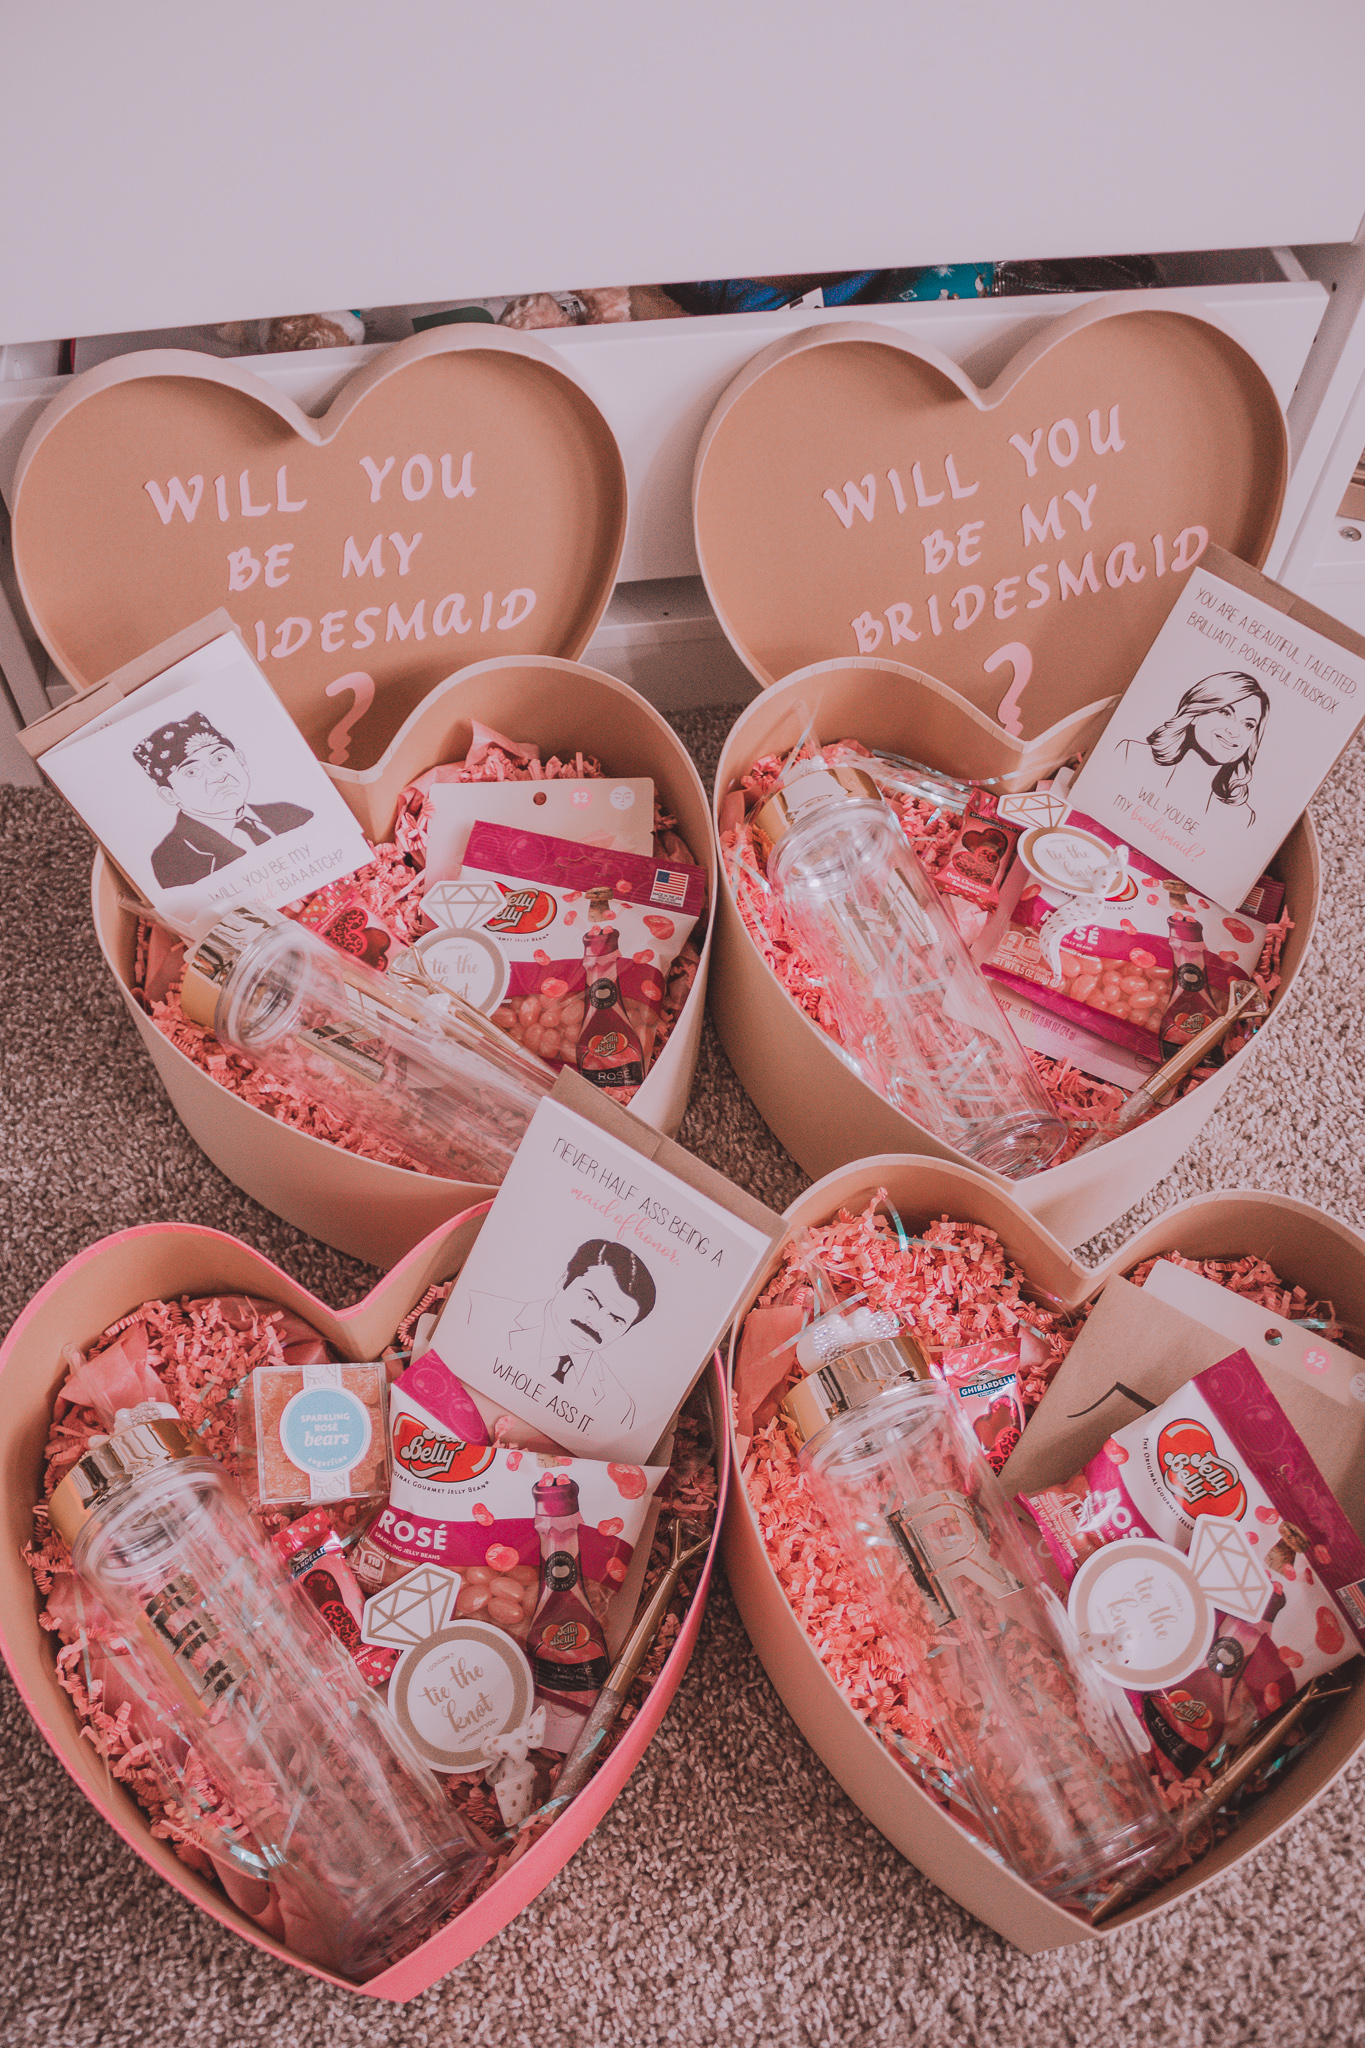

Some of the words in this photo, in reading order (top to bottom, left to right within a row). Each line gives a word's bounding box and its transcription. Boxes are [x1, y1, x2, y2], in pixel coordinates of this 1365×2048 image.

[143, 464, 307, 525] WILL
[359, 451, 476, 503] YOU
[822, 453, 979, 529] WILL
[1008, 404, 1126, 478] YOU
[921, 520, 985, 574] BE
[1021, 483, 1097, 547] MY
[226, 542, 294, 591] BE
[341, 531, 423, 578] MY
[850, 525, 1209, 654] BRIDESMAID
[252, 588, 537, 662] IDESMAID
[1195, 586, 1218, 609] YOU
[1216, 602, 1240, 622] ARE
[1237, 616, 1249, 630] A
[1303, 653, 1357, 699] TALENTED,
[1237, 643, 1292, 687] POWERFUL
[983, 641, 1034, 737] ?
[325, 671, 376, 765] ?
[572, 791, 588, 804] $2
[1138, 786, 1160, 811] WILL
[1163, 803, 1185, 825] YOU
[1182, 817, 1200, 835] BE
[1113, 794, 1134, 812] MY
[1129, 804, 1206, 862] bridesmaid?
[208, 882, 243, 901] WILL
[241, 866, 270, 888] YOU
[268, 856, 290, 875] BE
[288, 844, 311, 865] MY
[276, 848, 343, 892] BIAAATCH?
[1063, 844, 1091, 860] the
[946, 871, 961, 882] Dark
[961, 877, 990, 894] Chocolate
[952, 880, 980, 896] Raspberry
[485, 906, 524, 932] elly
[1073, 926, 1100, 945] SÉ
[428, 957, 450, 975] tie
[455, 952, 480, 975] the
[597, 1067, 631, 1081] ROSÉ
[552, 1136, 599, 1180] NEVER
[598, 1167, 639, 1201] HALF
[638, 1196, 670, 1226] ASS
[668, 1215, 710, 1255] BEING
[710, 1249, 724, 1267] A
[571, 1187, 620, 1218] maid
[613, 1213, 640, 1241] of
[634, 1217, 680, 1266] honor.
[1306, 1351, 1326, 1369] $2
[300, 1412, 351, 1423] SPARKLING
[492, 1357, 546, 1403] WHOLE
[545, 1395, 578, 1424] ASS
[577, 1414, 595, 1436] IT.
[304, 1430, 350, 1447] bears
[314, 1421, 339, 1432] ROSÉ
[400, 1435, 456, 1479] Belly
[1143, 1452, 1157, 1486] ORIGINAL
[1163, 1451, 1208, 1506] Belly
[1190, 1450, 1240, 1499] Jelly
[412, 1480, 445, 1494] GOURMET
[447, 1487, 466, 1495] JELLY
[377, 1509, 448, 1551] ROSÉ
[1103, 1487, 1144, 1539] ROS
[375, 1531, 403, 1552] SPARKLING
[403, 1548, 420, 1557] JELLY
[420, 1552, 441, 1561] BEANS
[884, 1490, 1025, 1628] R
[1134, 1569, 1154, 1604] tie
[1147, 1603, 1178, 1641] the
[549, 1634, 577, 1651] Belly
[418, 1686, 451, 1706] tie
[448, 1656, 484, 1689] the
[441, 1692, 494, 1733] knot
